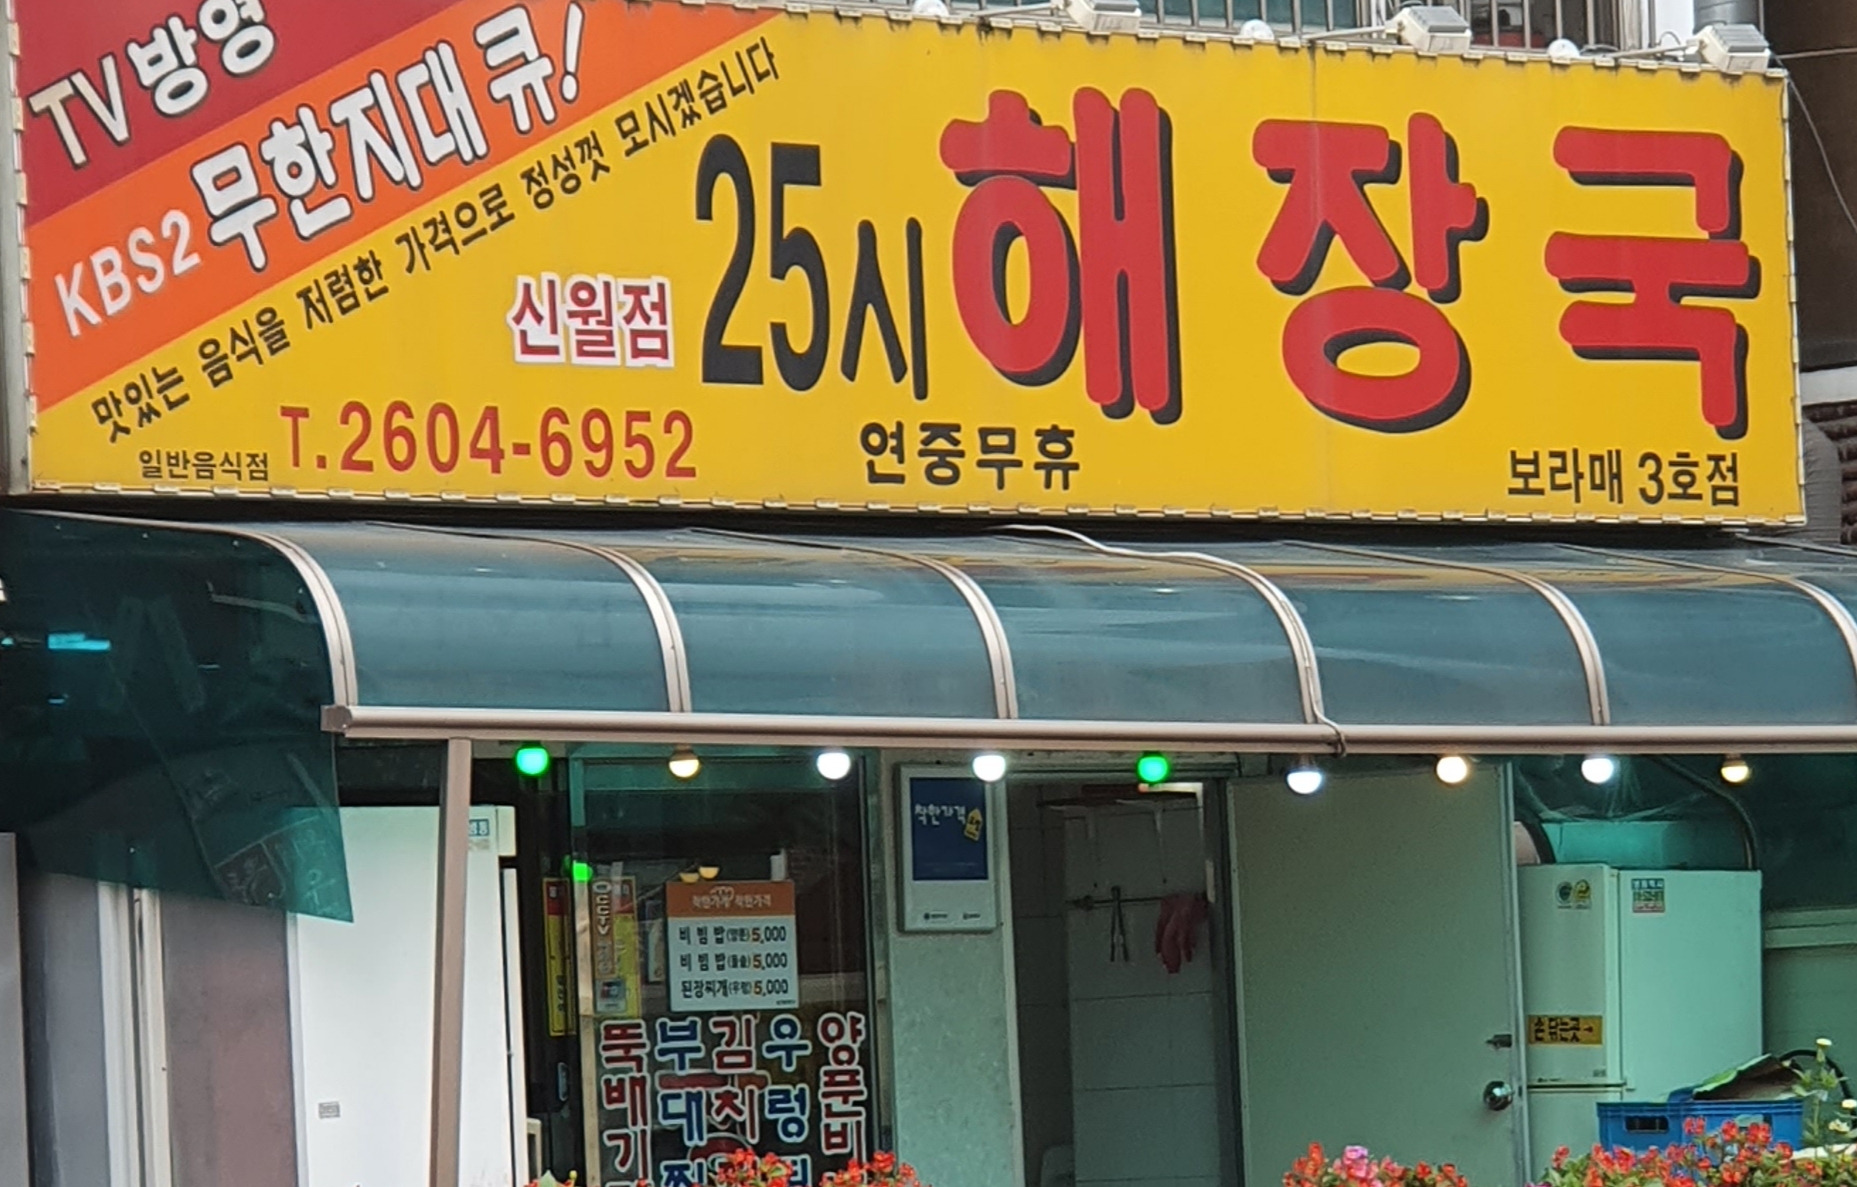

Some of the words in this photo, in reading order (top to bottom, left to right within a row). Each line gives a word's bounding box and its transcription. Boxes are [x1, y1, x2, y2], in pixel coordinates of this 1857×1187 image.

[54, 208, 204, 338] KBS2
[190, 39, 490, 272] 무한지대
[473, 2, 586, 136] 큐!
[91, 365, 190, 443] 맛있는
[197, 306, 291, 388] 음식을
[296, 249, 390, 330] 저렴한
[395, 182, 516, 276] 가격으로
[519, 129, 611, 210] 정성껏
[614, 35, 780, 158] 모시겠습니다
[696, 133, 929, 401] 25시
[508, 275, 676, 367] 신월점
[137, 449, 270, 481] 일반음식점
[280, 400, 698, 481] T.2604-6952
[859, 420, 1081, 491] 연중무휴
[1507, 447, 1624, 504] 보라매
[1637, 451, 1741, 507] 3호점
[708, 1014, 760, 1185] 김치
[817, 1011, 868, 1176] 양푼비
